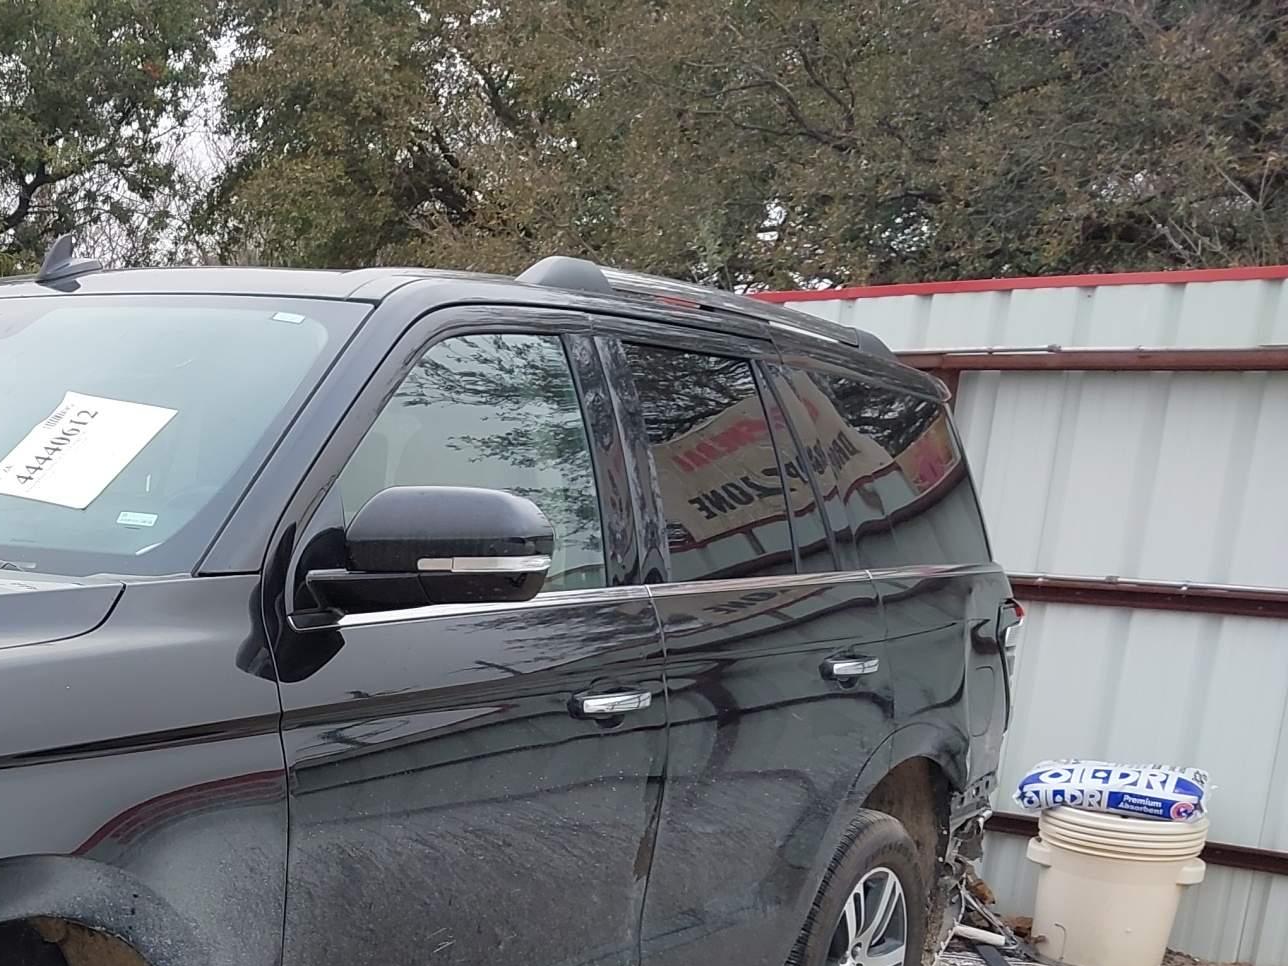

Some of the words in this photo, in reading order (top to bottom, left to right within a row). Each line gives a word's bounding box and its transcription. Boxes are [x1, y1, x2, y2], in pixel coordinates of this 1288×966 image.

[15, 409, 99, 485] 44440612
[1123, 793, 1163, 808] Premium
[1118, 802, 1164, 816] Absorbent
